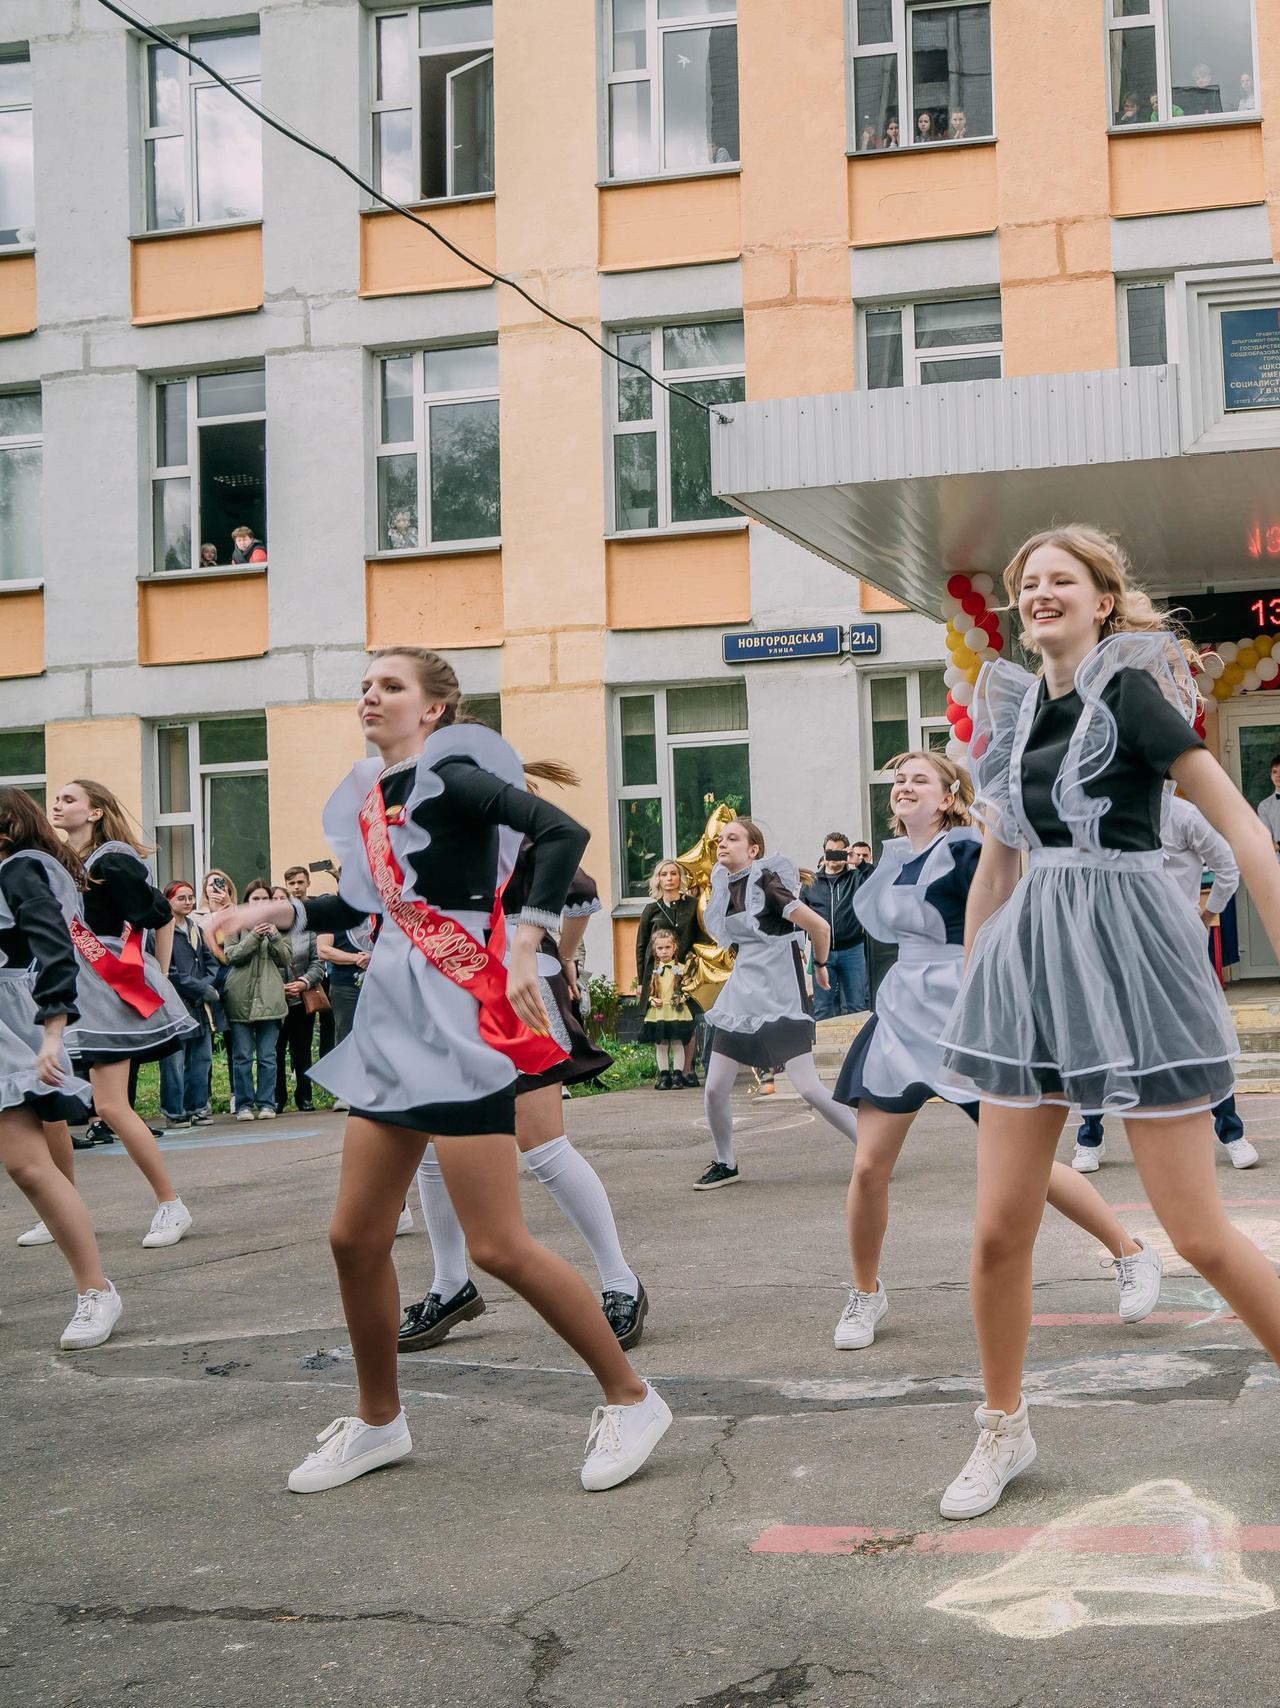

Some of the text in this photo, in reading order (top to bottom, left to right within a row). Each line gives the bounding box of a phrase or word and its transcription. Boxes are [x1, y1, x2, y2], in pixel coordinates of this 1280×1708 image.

[738, 632, 824, 649] НОВГОРОДСКАЯ
[852, 631, 875, 645] 21А
[768, 647, 794, 655] УЛИЦА
[75, 930, 107, 962] 2022
[422, 920, 490, 981] 2022
